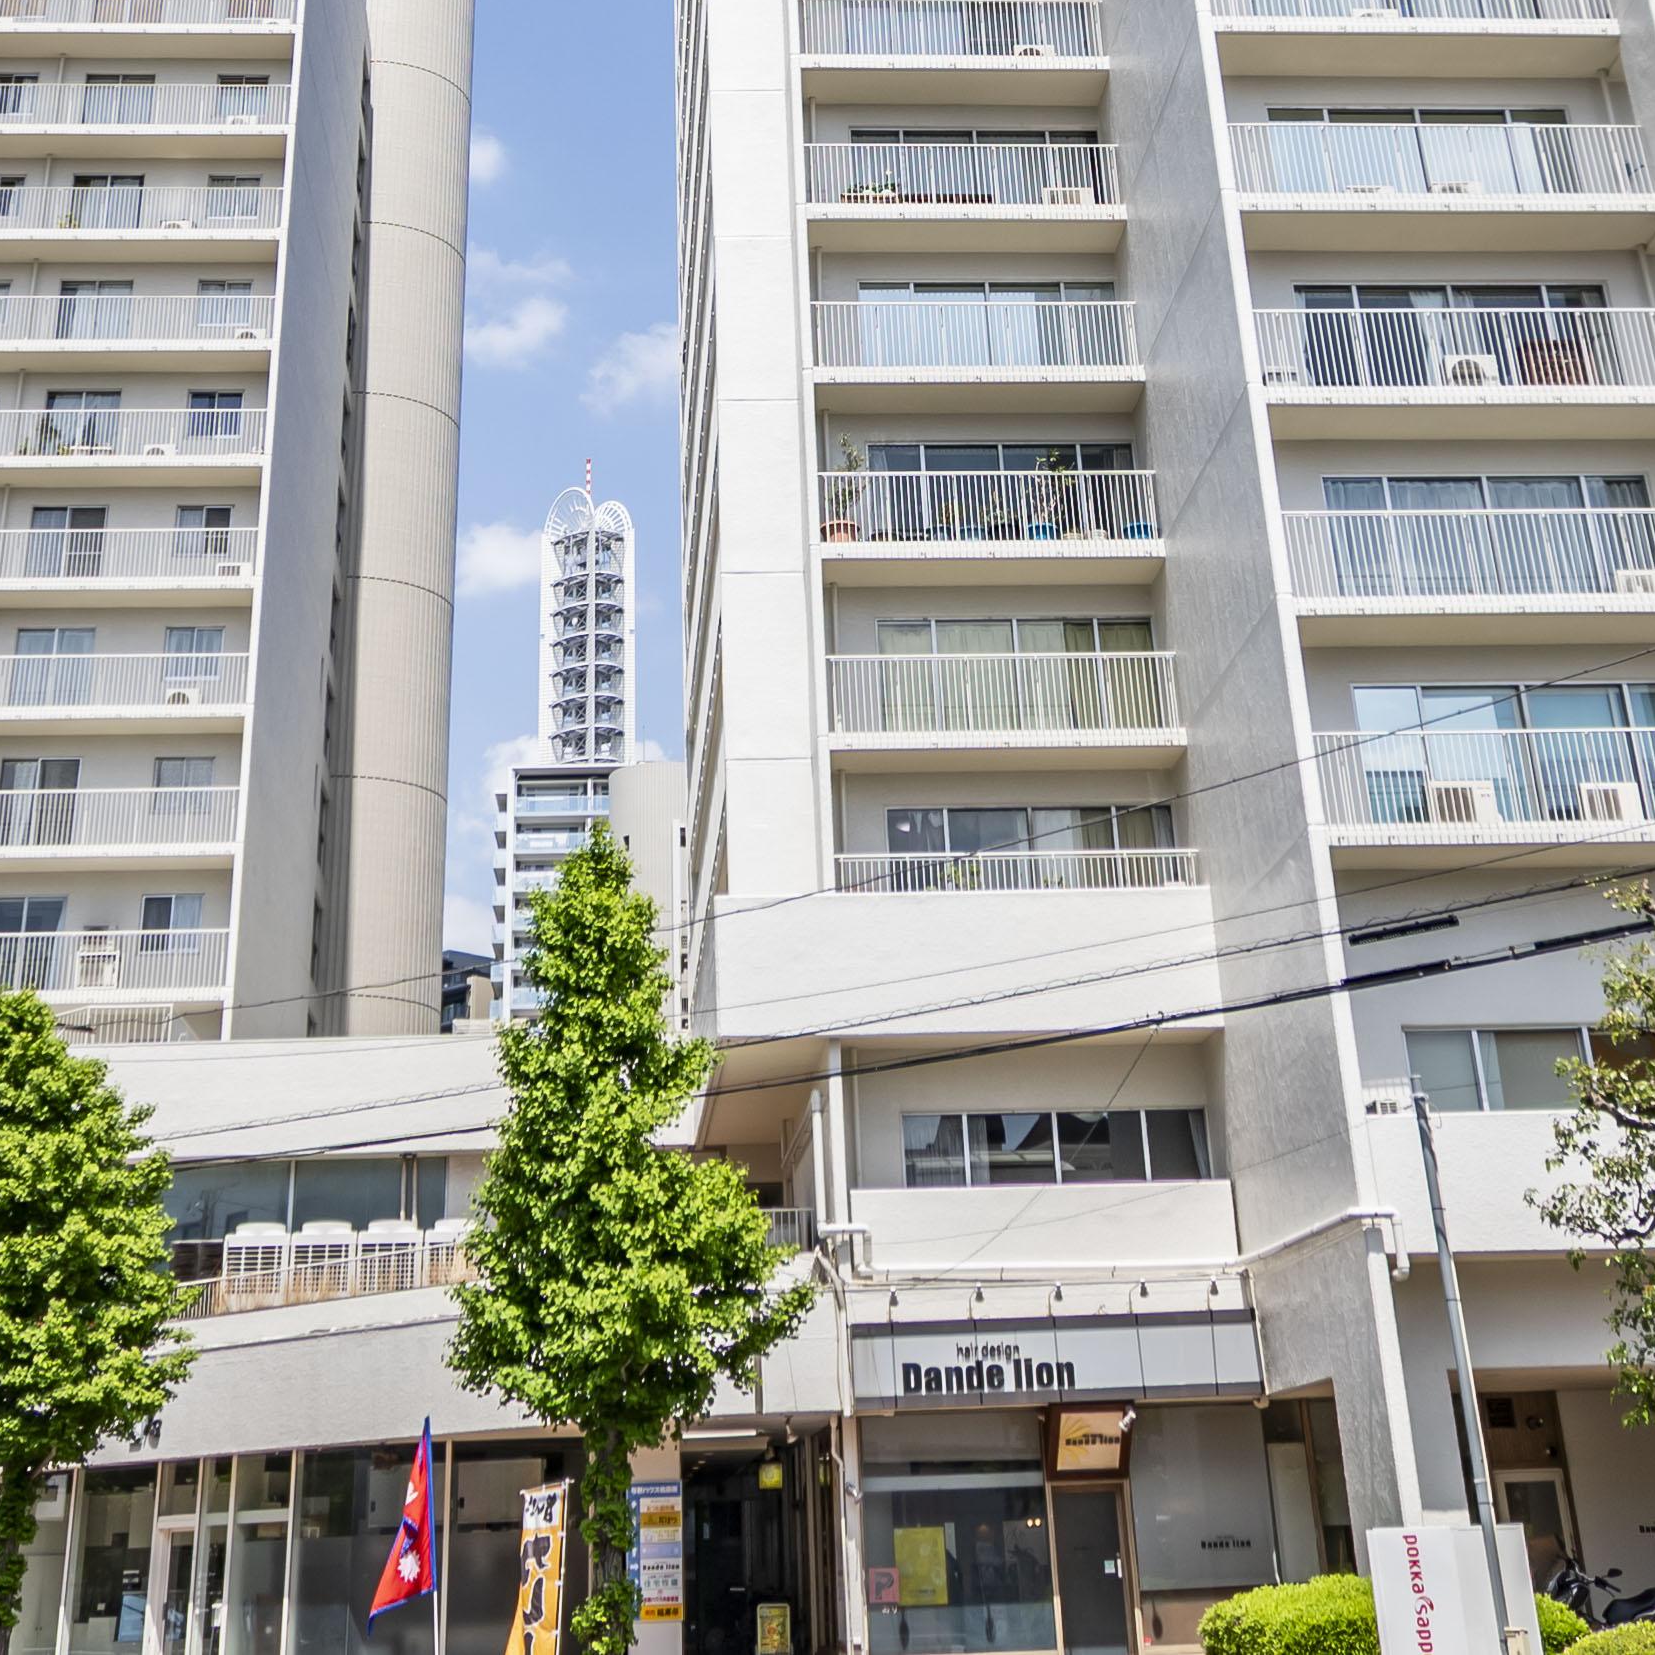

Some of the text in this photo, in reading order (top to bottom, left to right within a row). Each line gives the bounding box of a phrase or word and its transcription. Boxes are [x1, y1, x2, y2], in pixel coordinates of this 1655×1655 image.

[956, 1341, 1020, 1364] hair design
[902, 1358, 1076, 1395] Dande lion
[1415, 1604, 1436, 1655] sapp
